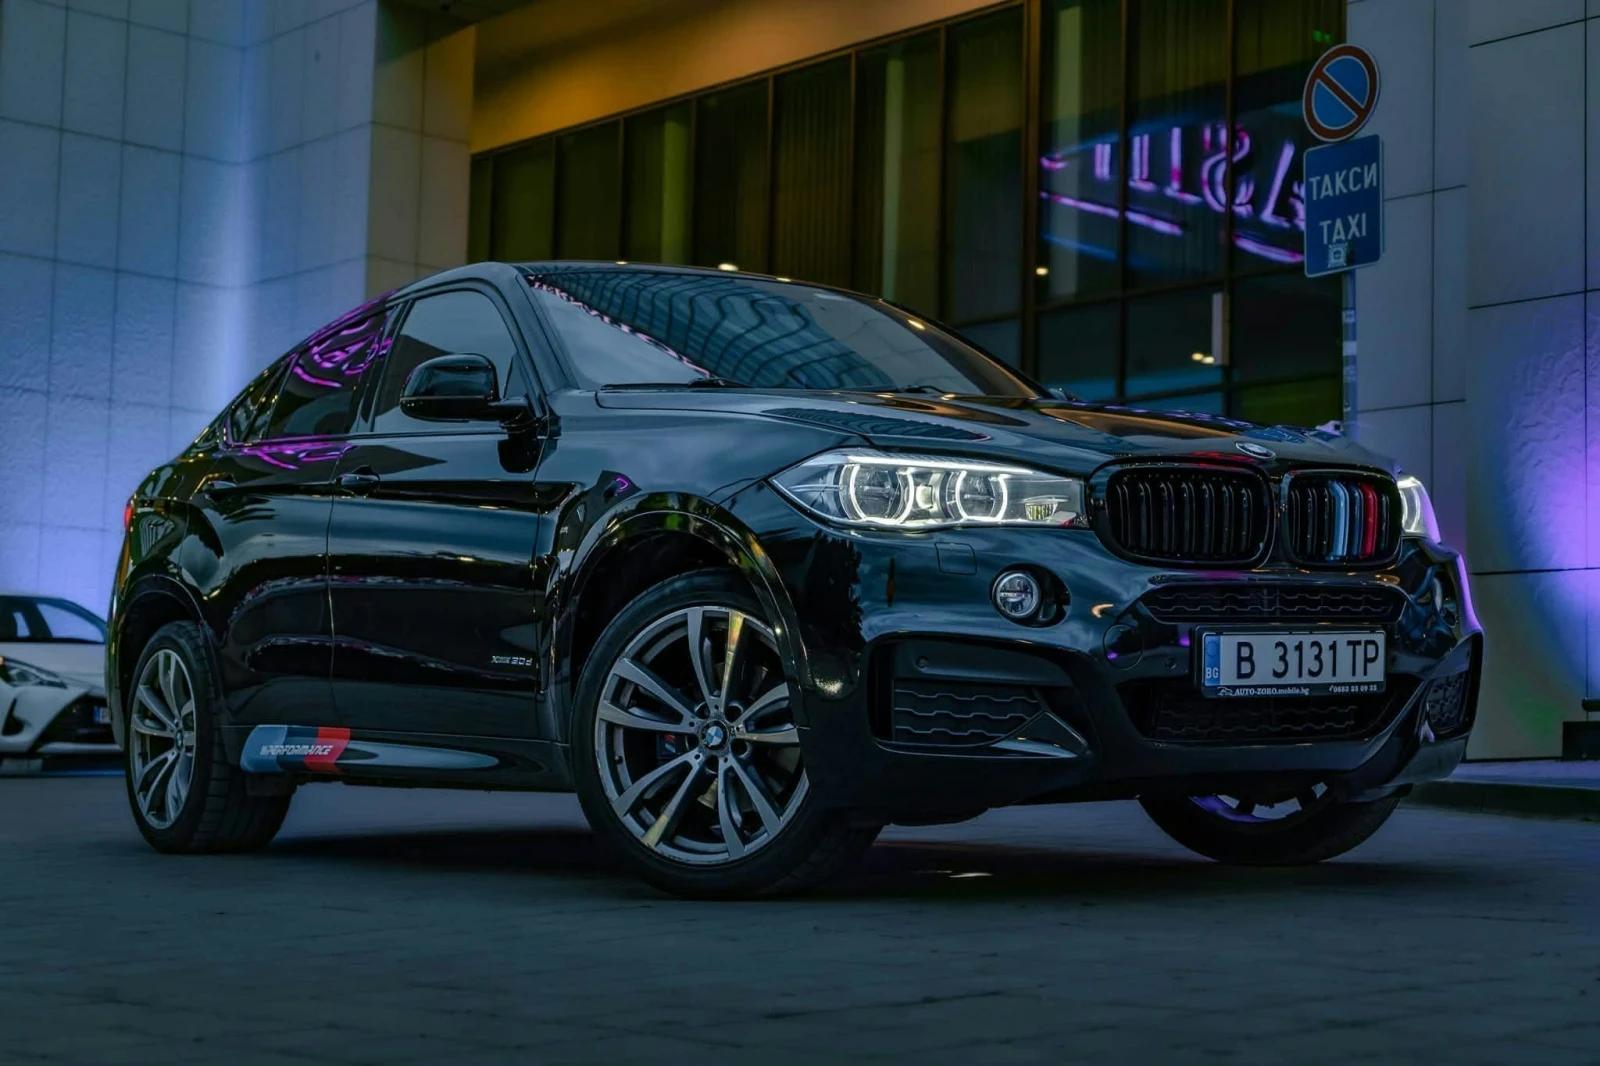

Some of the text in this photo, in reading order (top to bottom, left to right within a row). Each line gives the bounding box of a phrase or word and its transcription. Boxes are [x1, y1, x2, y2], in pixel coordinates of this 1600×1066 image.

[1309, 162, 1377, 201] ТАКСИ
[1319, 213, 1366, 245] TAXI
[1205, 666, 1219, 679] BG
[1236, 639, 1379, 679] B 3131 TP
